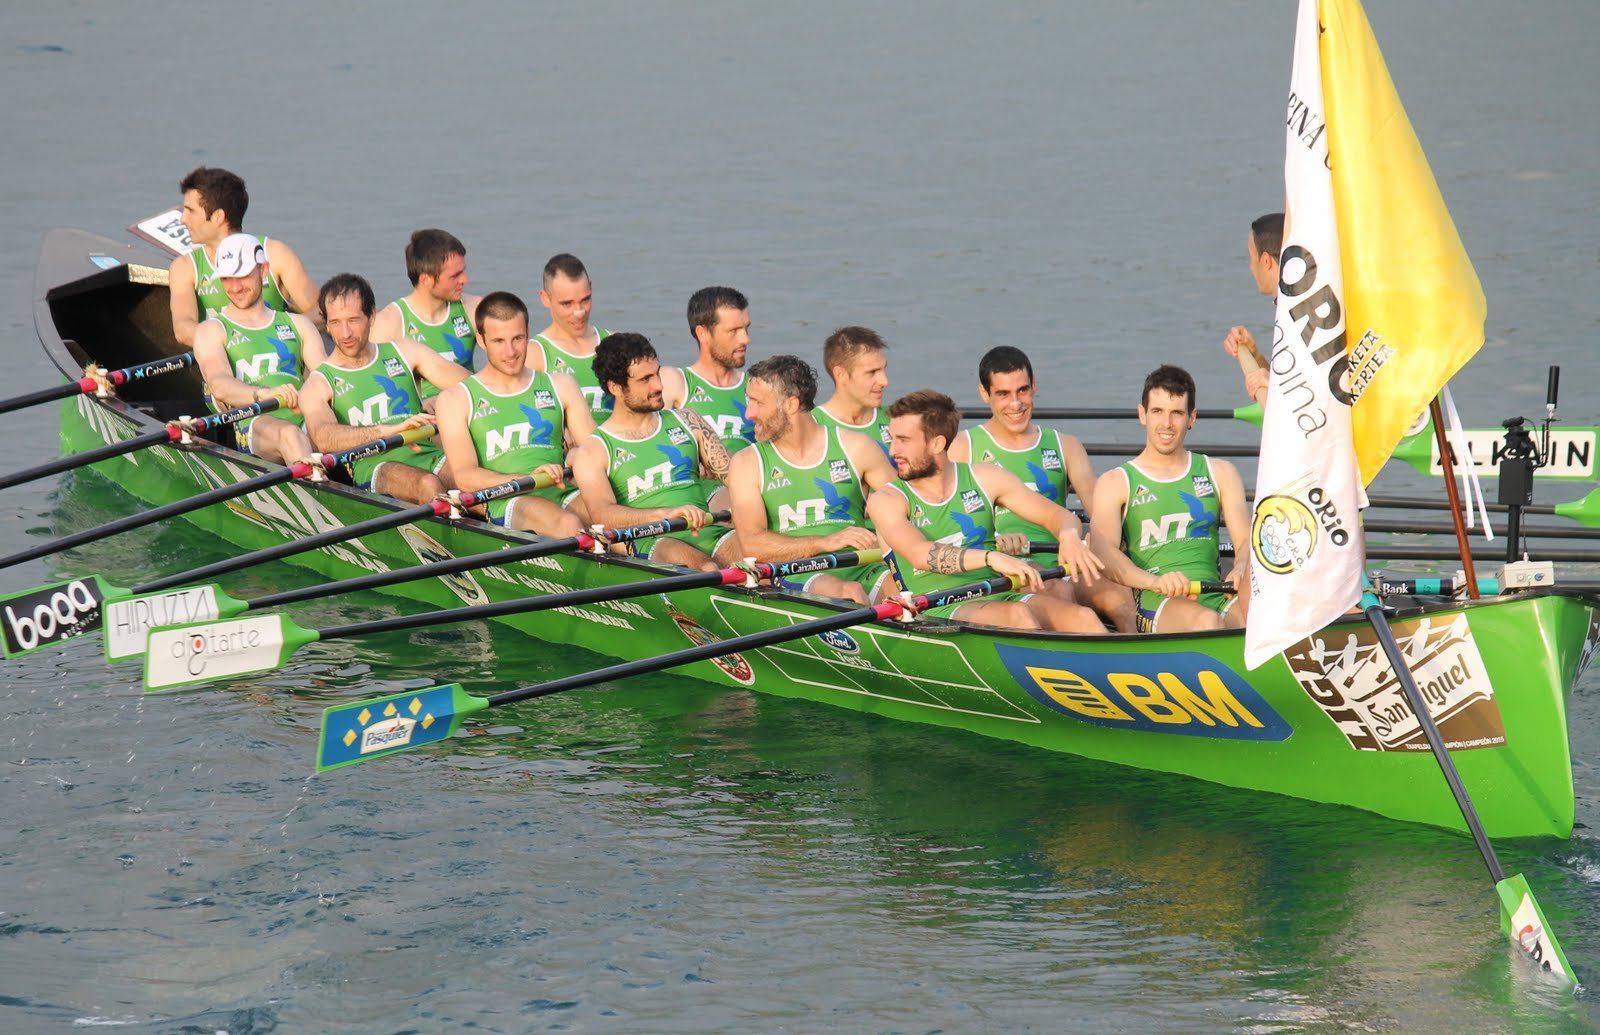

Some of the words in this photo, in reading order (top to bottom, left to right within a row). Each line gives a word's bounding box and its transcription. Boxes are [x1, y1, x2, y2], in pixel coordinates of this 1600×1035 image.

[227, 335, 250, 349] AIA
[146, 359, 185, 377] CaixaBank
[688, 395, 713, 404] AIA
[221, 406, 255, 425] CaixaBank
[473, 406, 499, 420] AIA
[348, 444, 380, 462] CaixaBank
[830, 459, 846, 468] LIGA
[767, 478, 793, 491] AIA
[1193, 475, 1209, 483] LIGA
[484, 482, 515, 499] CaixaBank
[962, 489, 978, 499] LIGA
[1132, 493, 1158, 507] AIA
[633, 523, 664, 538] CaixaBank
[791, 558, 830, 574] CaixaBank
[1382, 583, 1409, 594] Bank
[946, 588, 984, 605] CaixaBank
[170, 624, 261, 676] digitarte
[1106, 670, 1265, 728] BM
[1366, 701, 1410, 737] San
[366, 728, 409, 747] Pasquier
